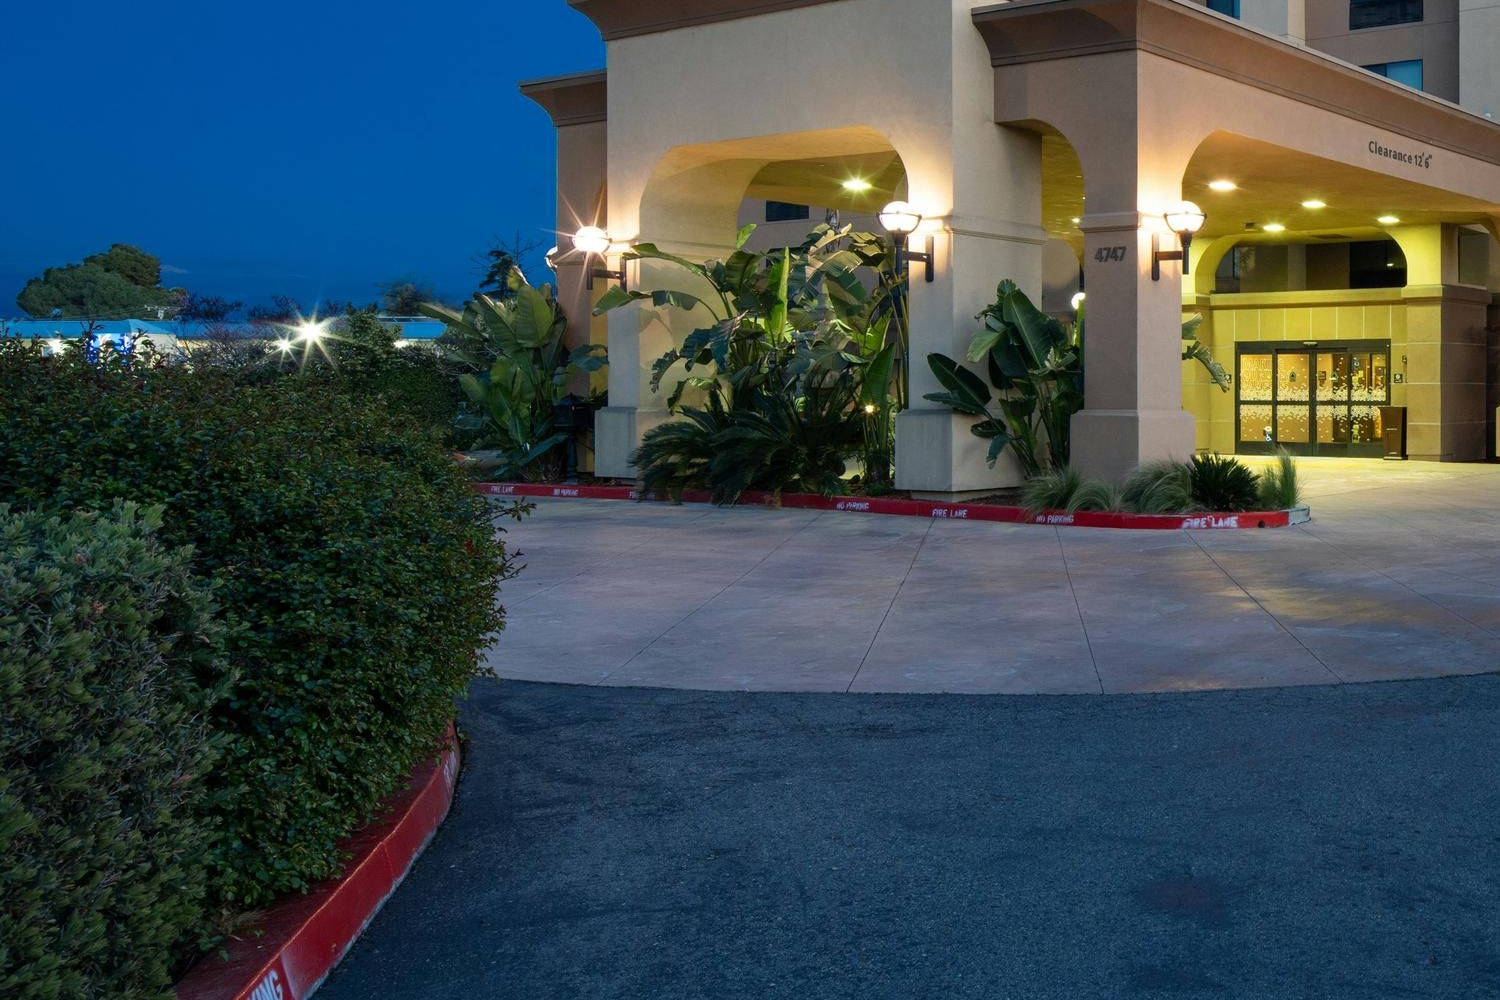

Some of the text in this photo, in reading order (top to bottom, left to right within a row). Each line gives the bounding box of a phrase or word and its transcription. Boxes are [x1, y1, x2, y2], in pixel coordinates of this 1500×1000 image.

[1368, 140, 1413, 164] Clearance
[1094, 246, 1127, 262] 4747
[932, 509, 968, 518] FIRE LANE
[1183, 516, 1239, 528] FIRE LANE
